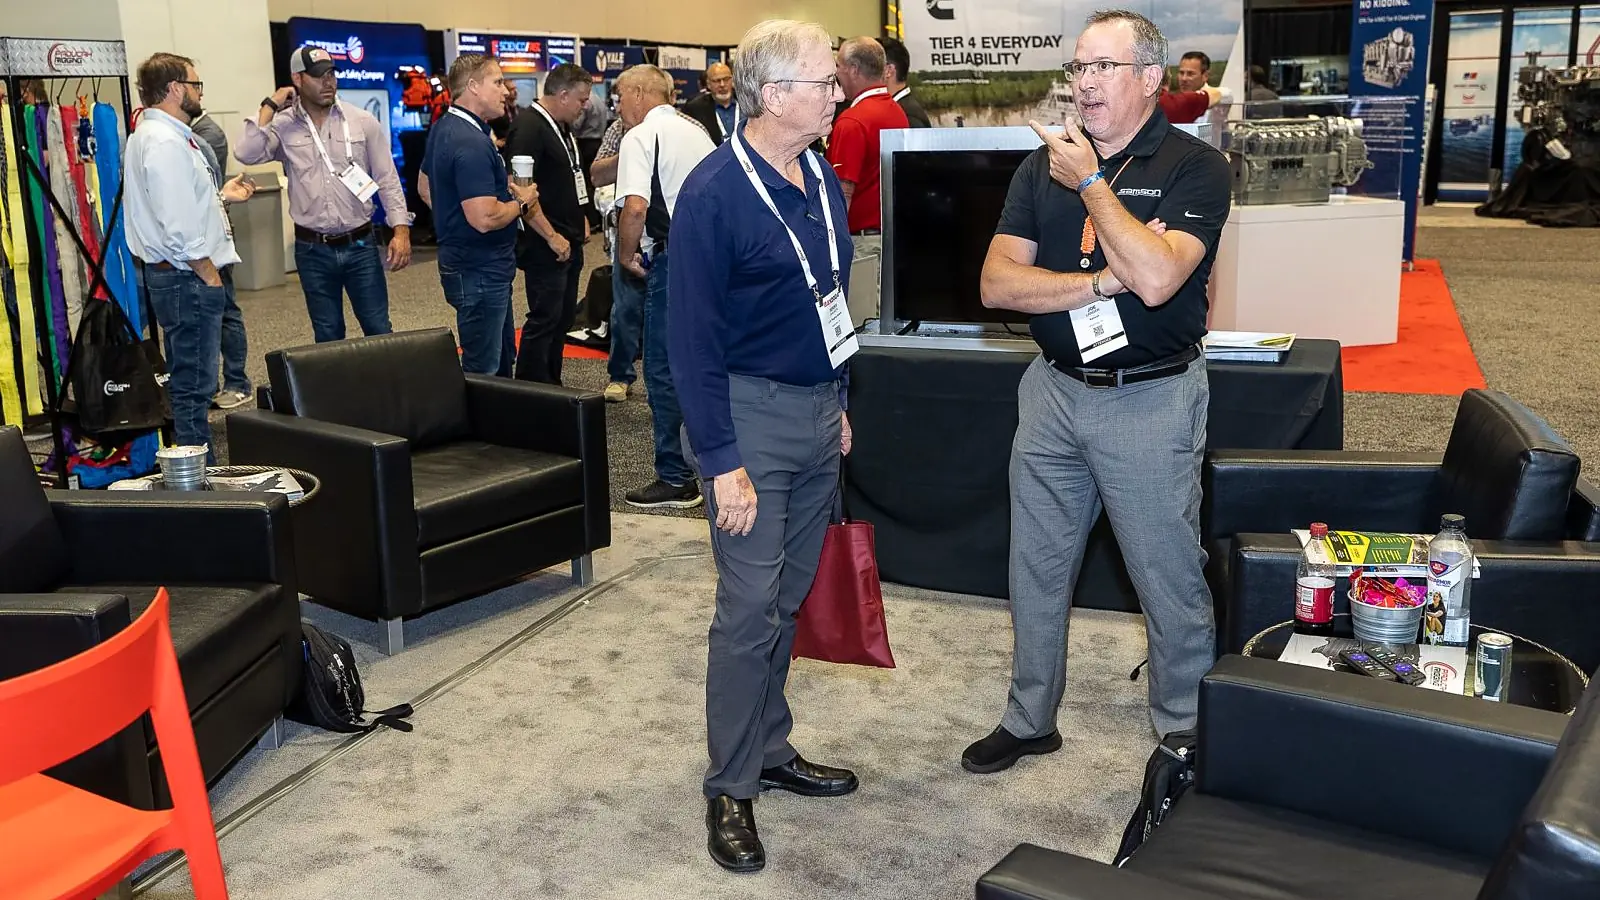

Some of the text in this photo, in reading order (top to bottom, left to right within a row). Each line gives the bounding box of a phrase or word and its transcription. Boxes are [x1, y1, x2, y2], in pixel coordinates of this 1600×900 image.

[1359, 0, 1371, 9] NO
[929, 35, 1063, 49] TIER 4 EVERYDAY
[606, 52, 625, 63] YALE
[931, 52, 1021, 66] RELIABILITY
